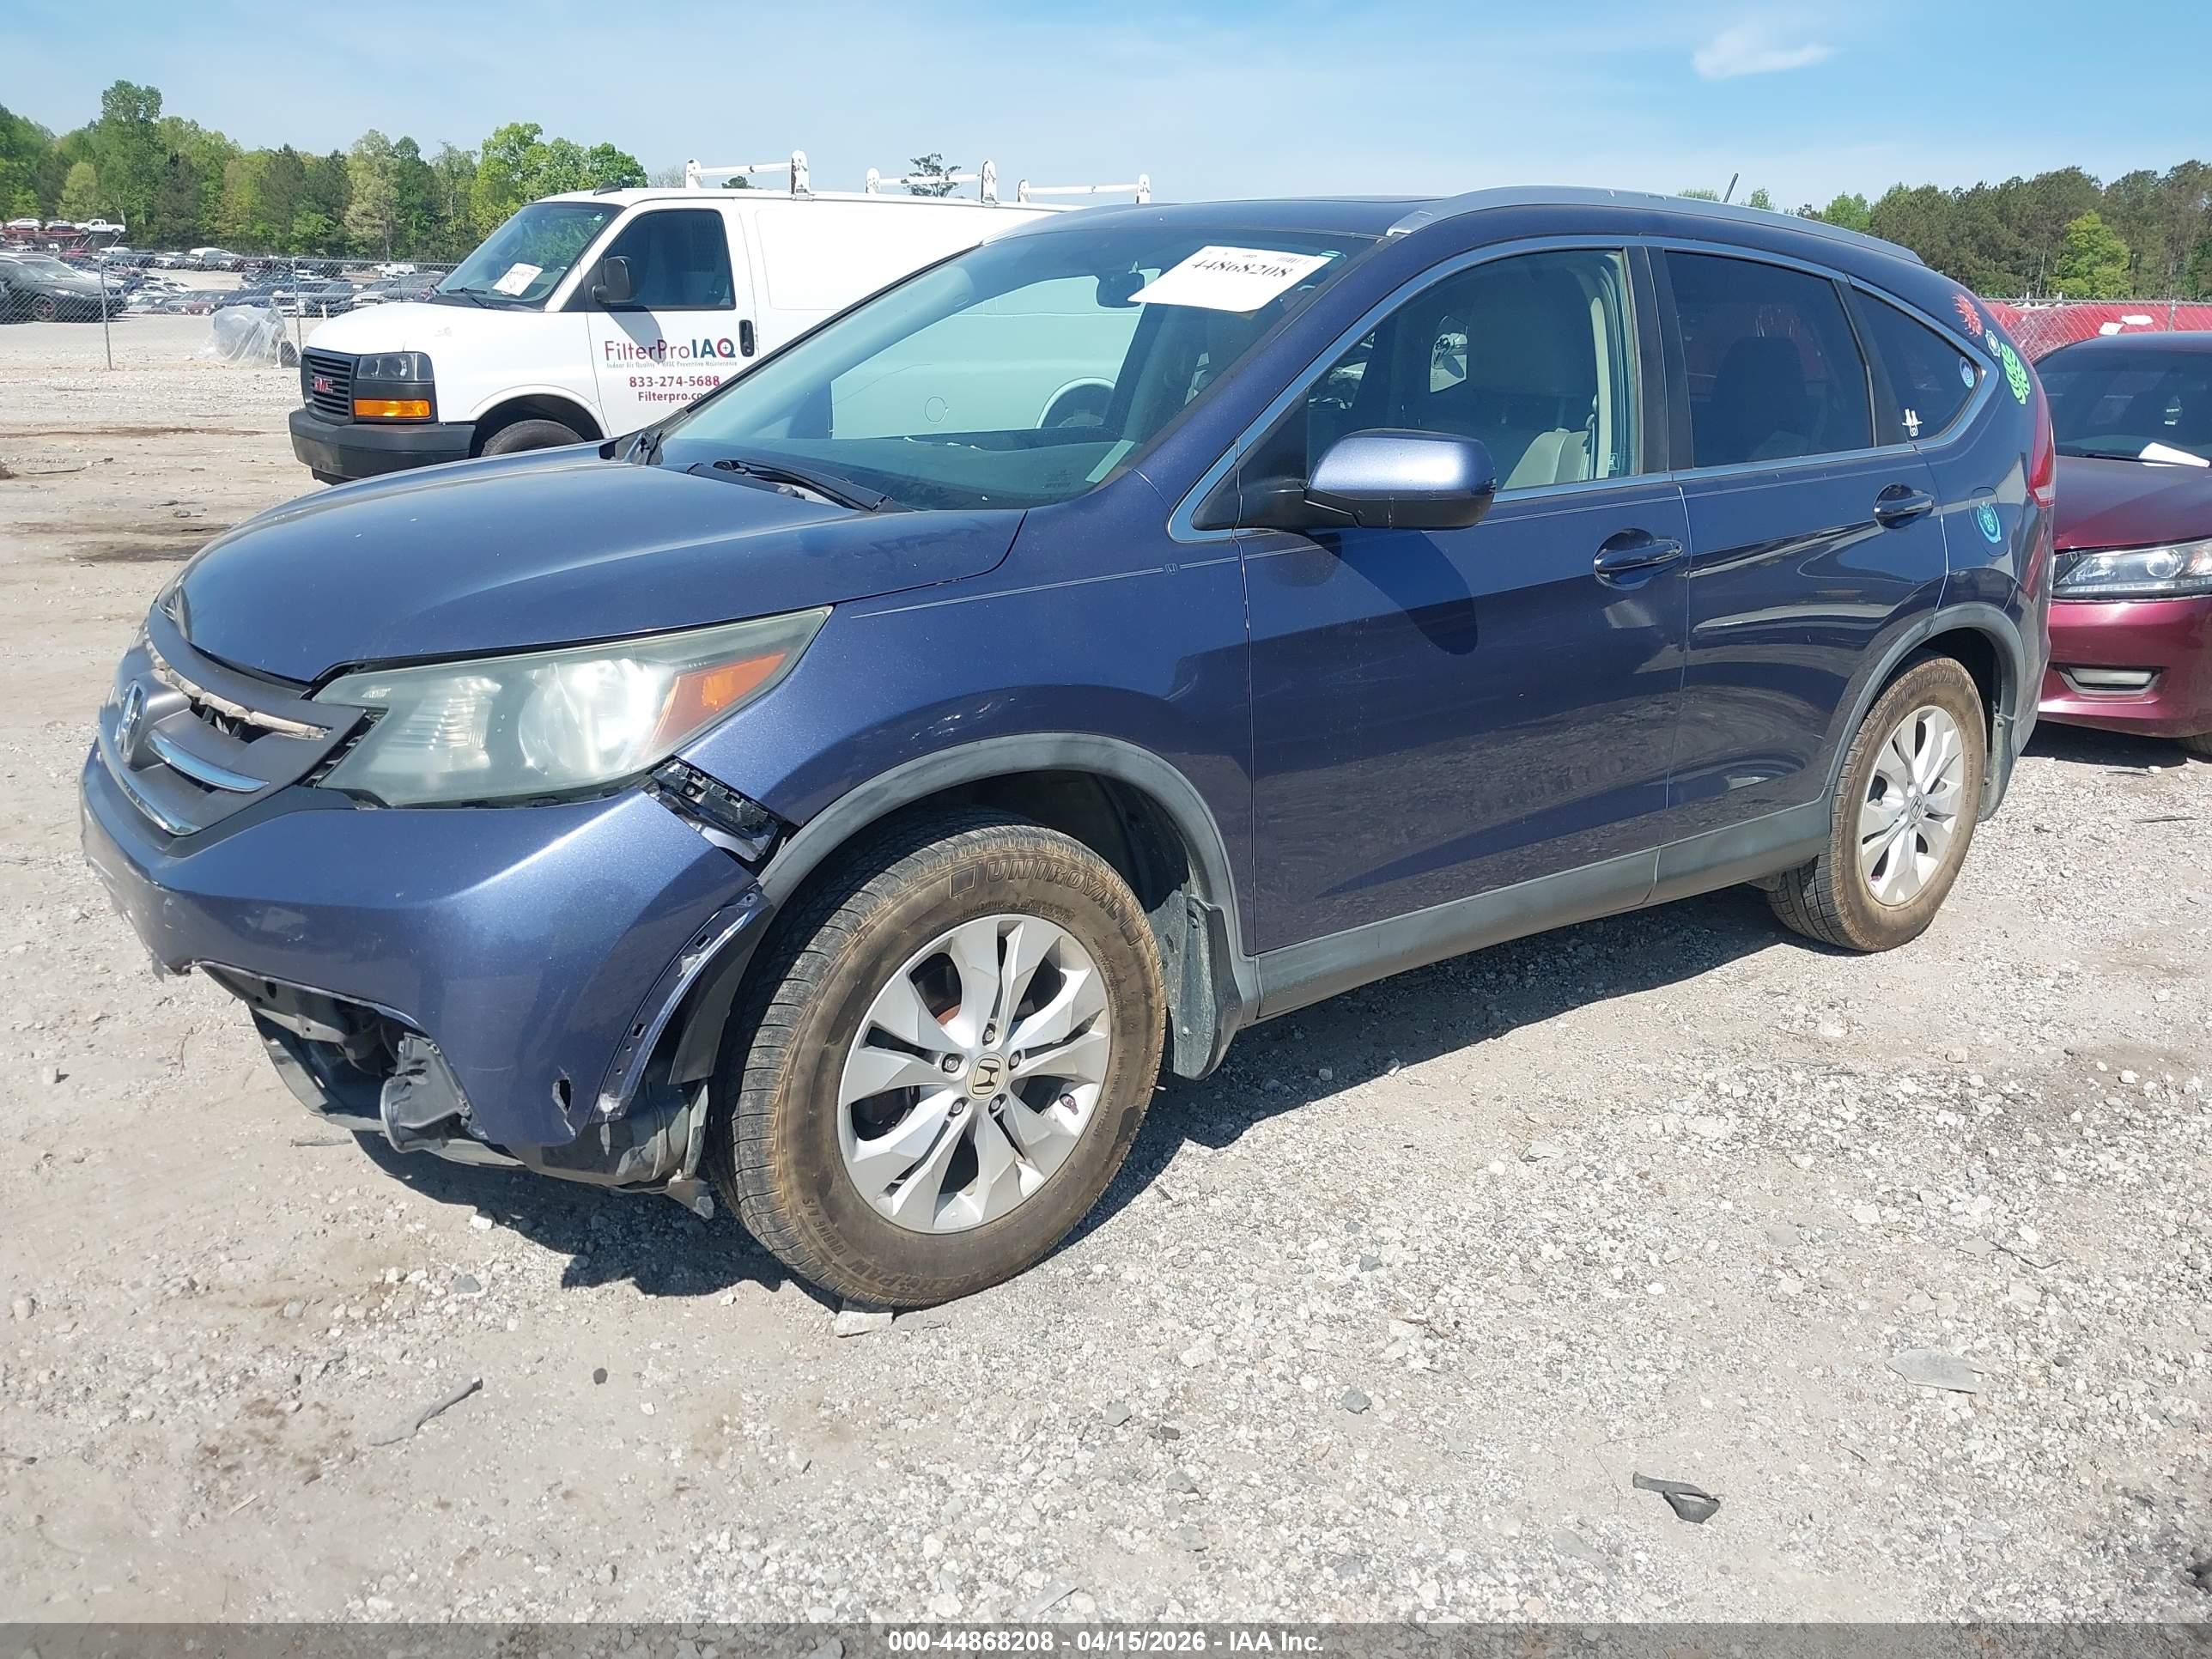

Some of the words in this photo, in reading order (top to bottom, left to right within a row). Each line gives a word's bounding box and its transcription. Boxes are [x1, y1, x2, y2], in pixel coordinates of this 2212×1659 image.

[1192, 258, 1294, 277] 44868208
[629, 375, 720, 387] 833-274-5688
[638, 391, 706, 404] Filterpro.co
[987, 859, 1121, 921] UNIROYAL
